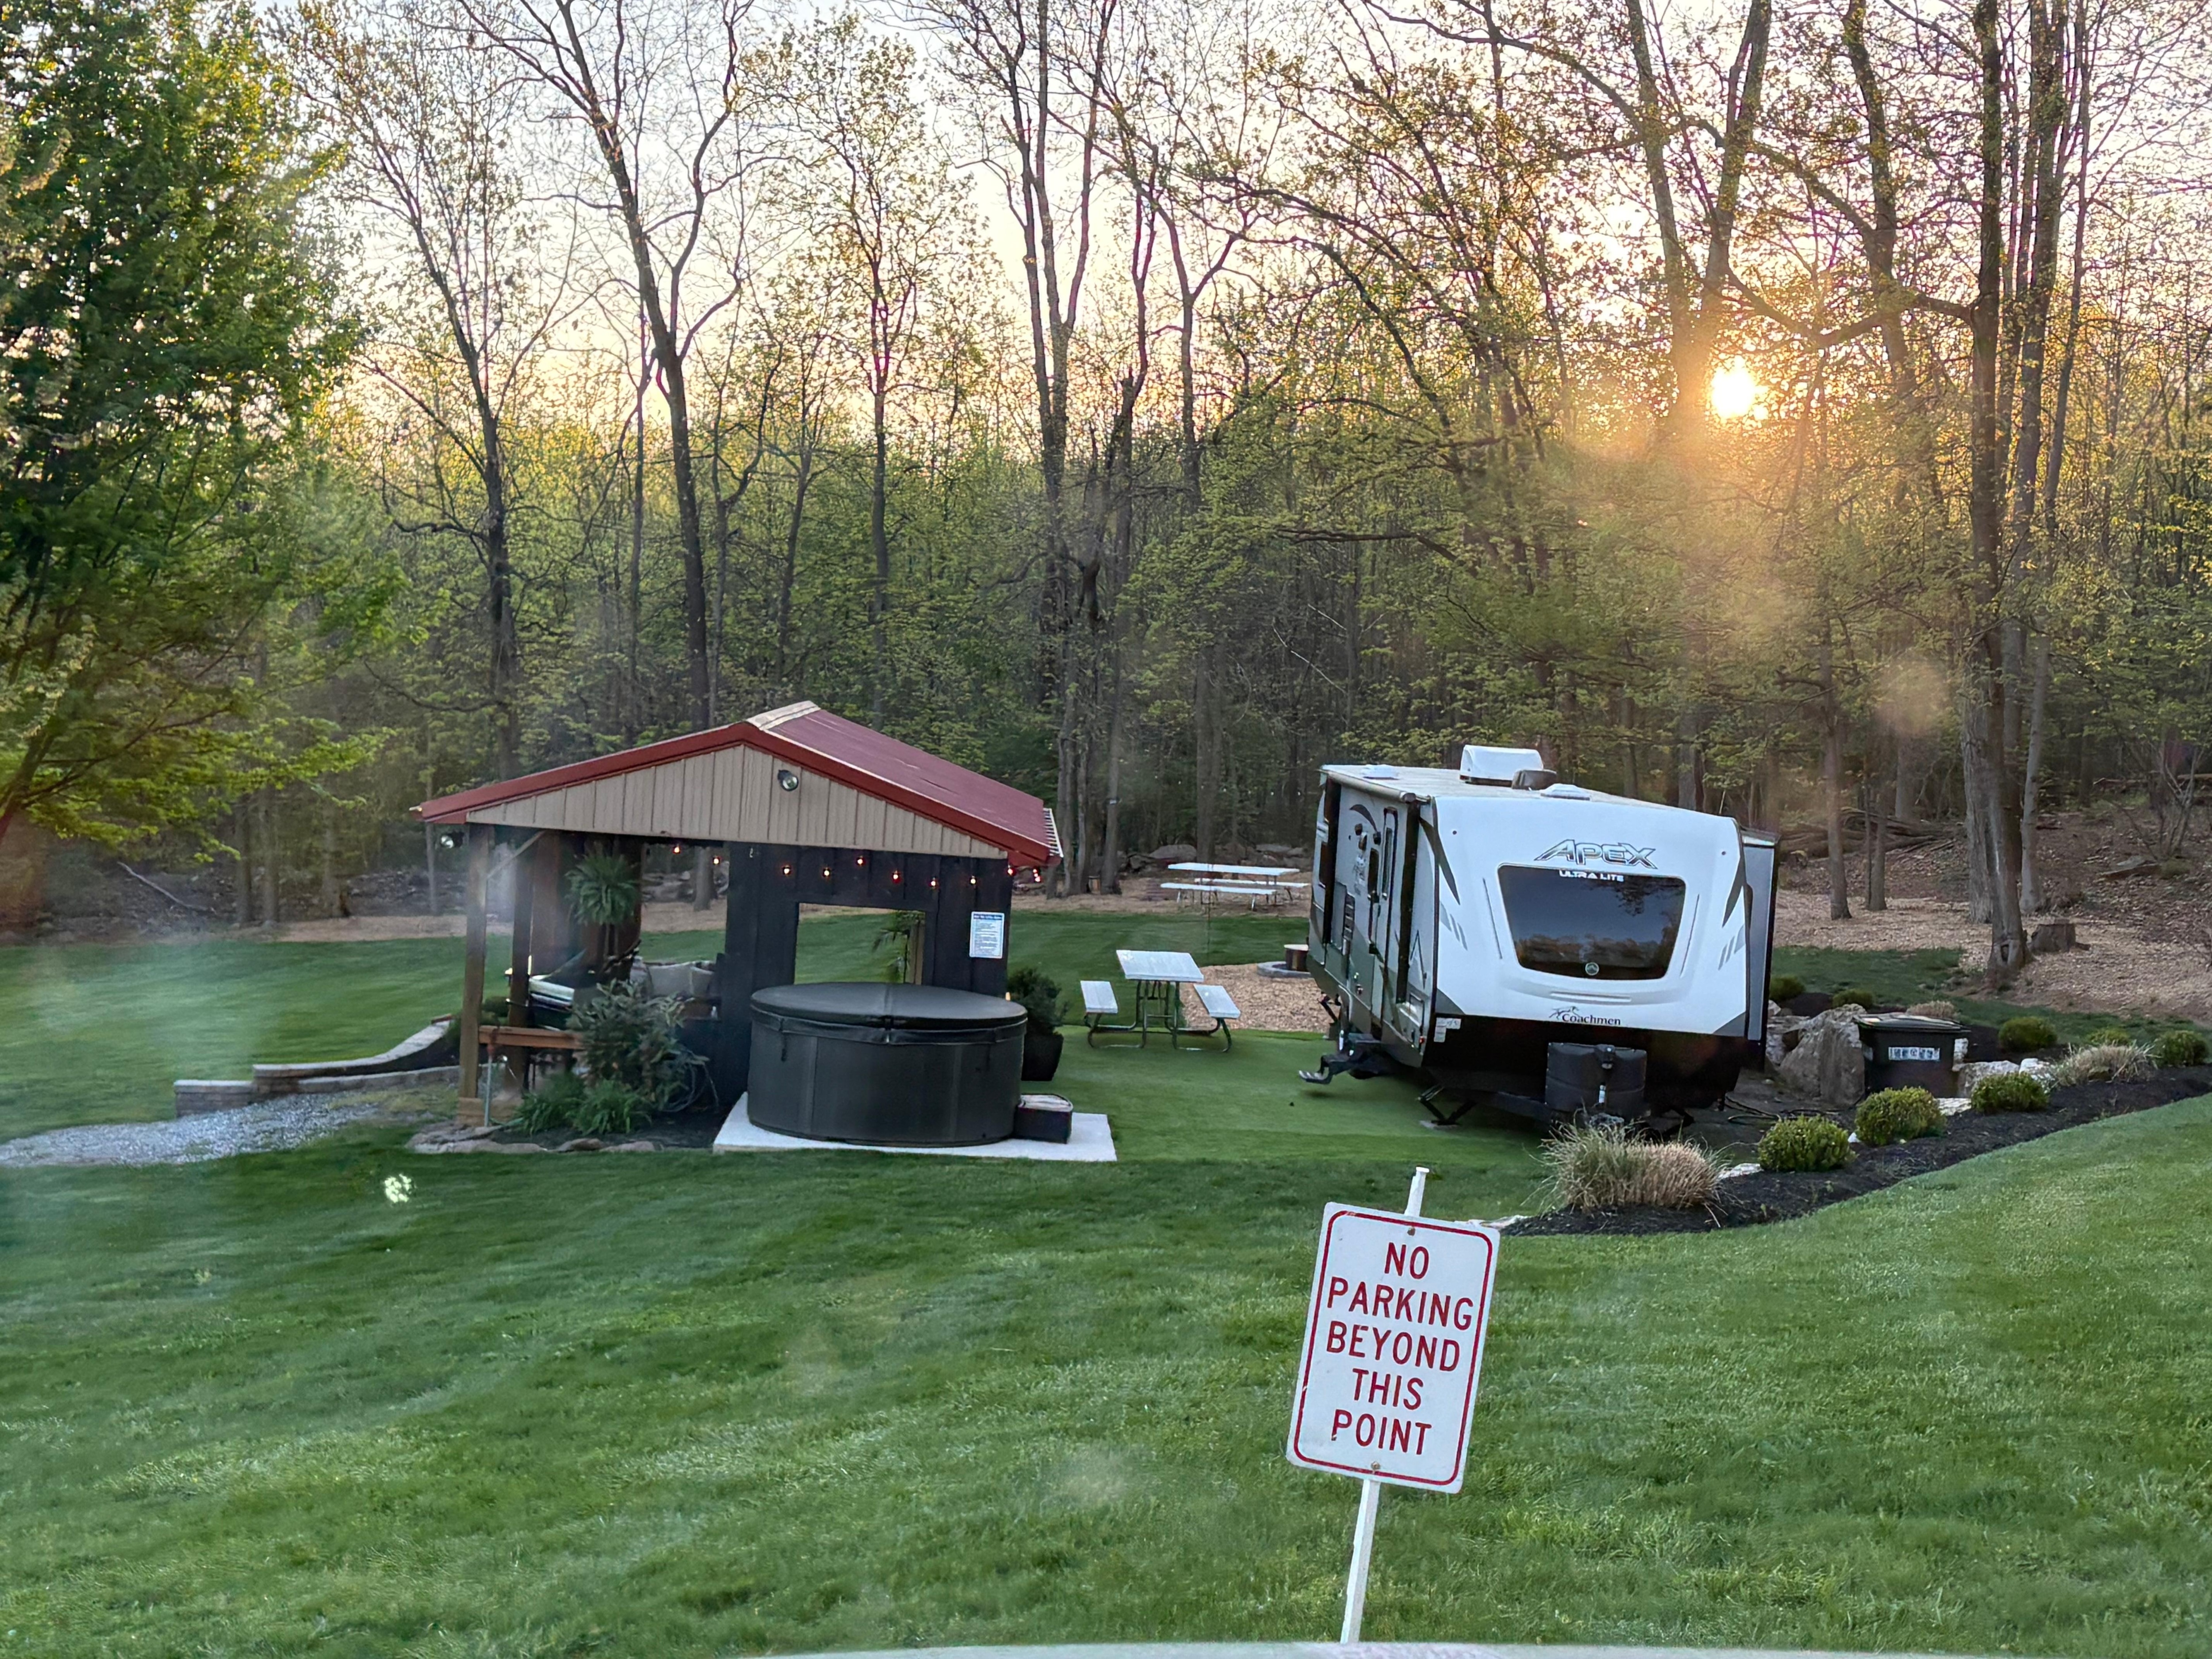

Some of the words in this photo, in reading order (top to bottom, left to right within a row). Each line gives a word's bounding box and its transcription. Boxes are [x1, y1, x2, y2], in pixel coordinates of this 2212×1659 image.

[1533, 839, 1659, 870] APEX
[1559, 870, 1598, 880] ULTRA
[1600, 873, 1624, 882] LITE
[1562, 1013, 1621, 1025] Coachmen
[1384, 1242, 1429, 1279] NO
[1327, 1276, 1474, 1331] PARKING
[1327, 1321, 1460, 1371] BEYOND
[1352, 1368, 1424, 1410] THIS
[1331, 1409, 1432, 1455] POINT
